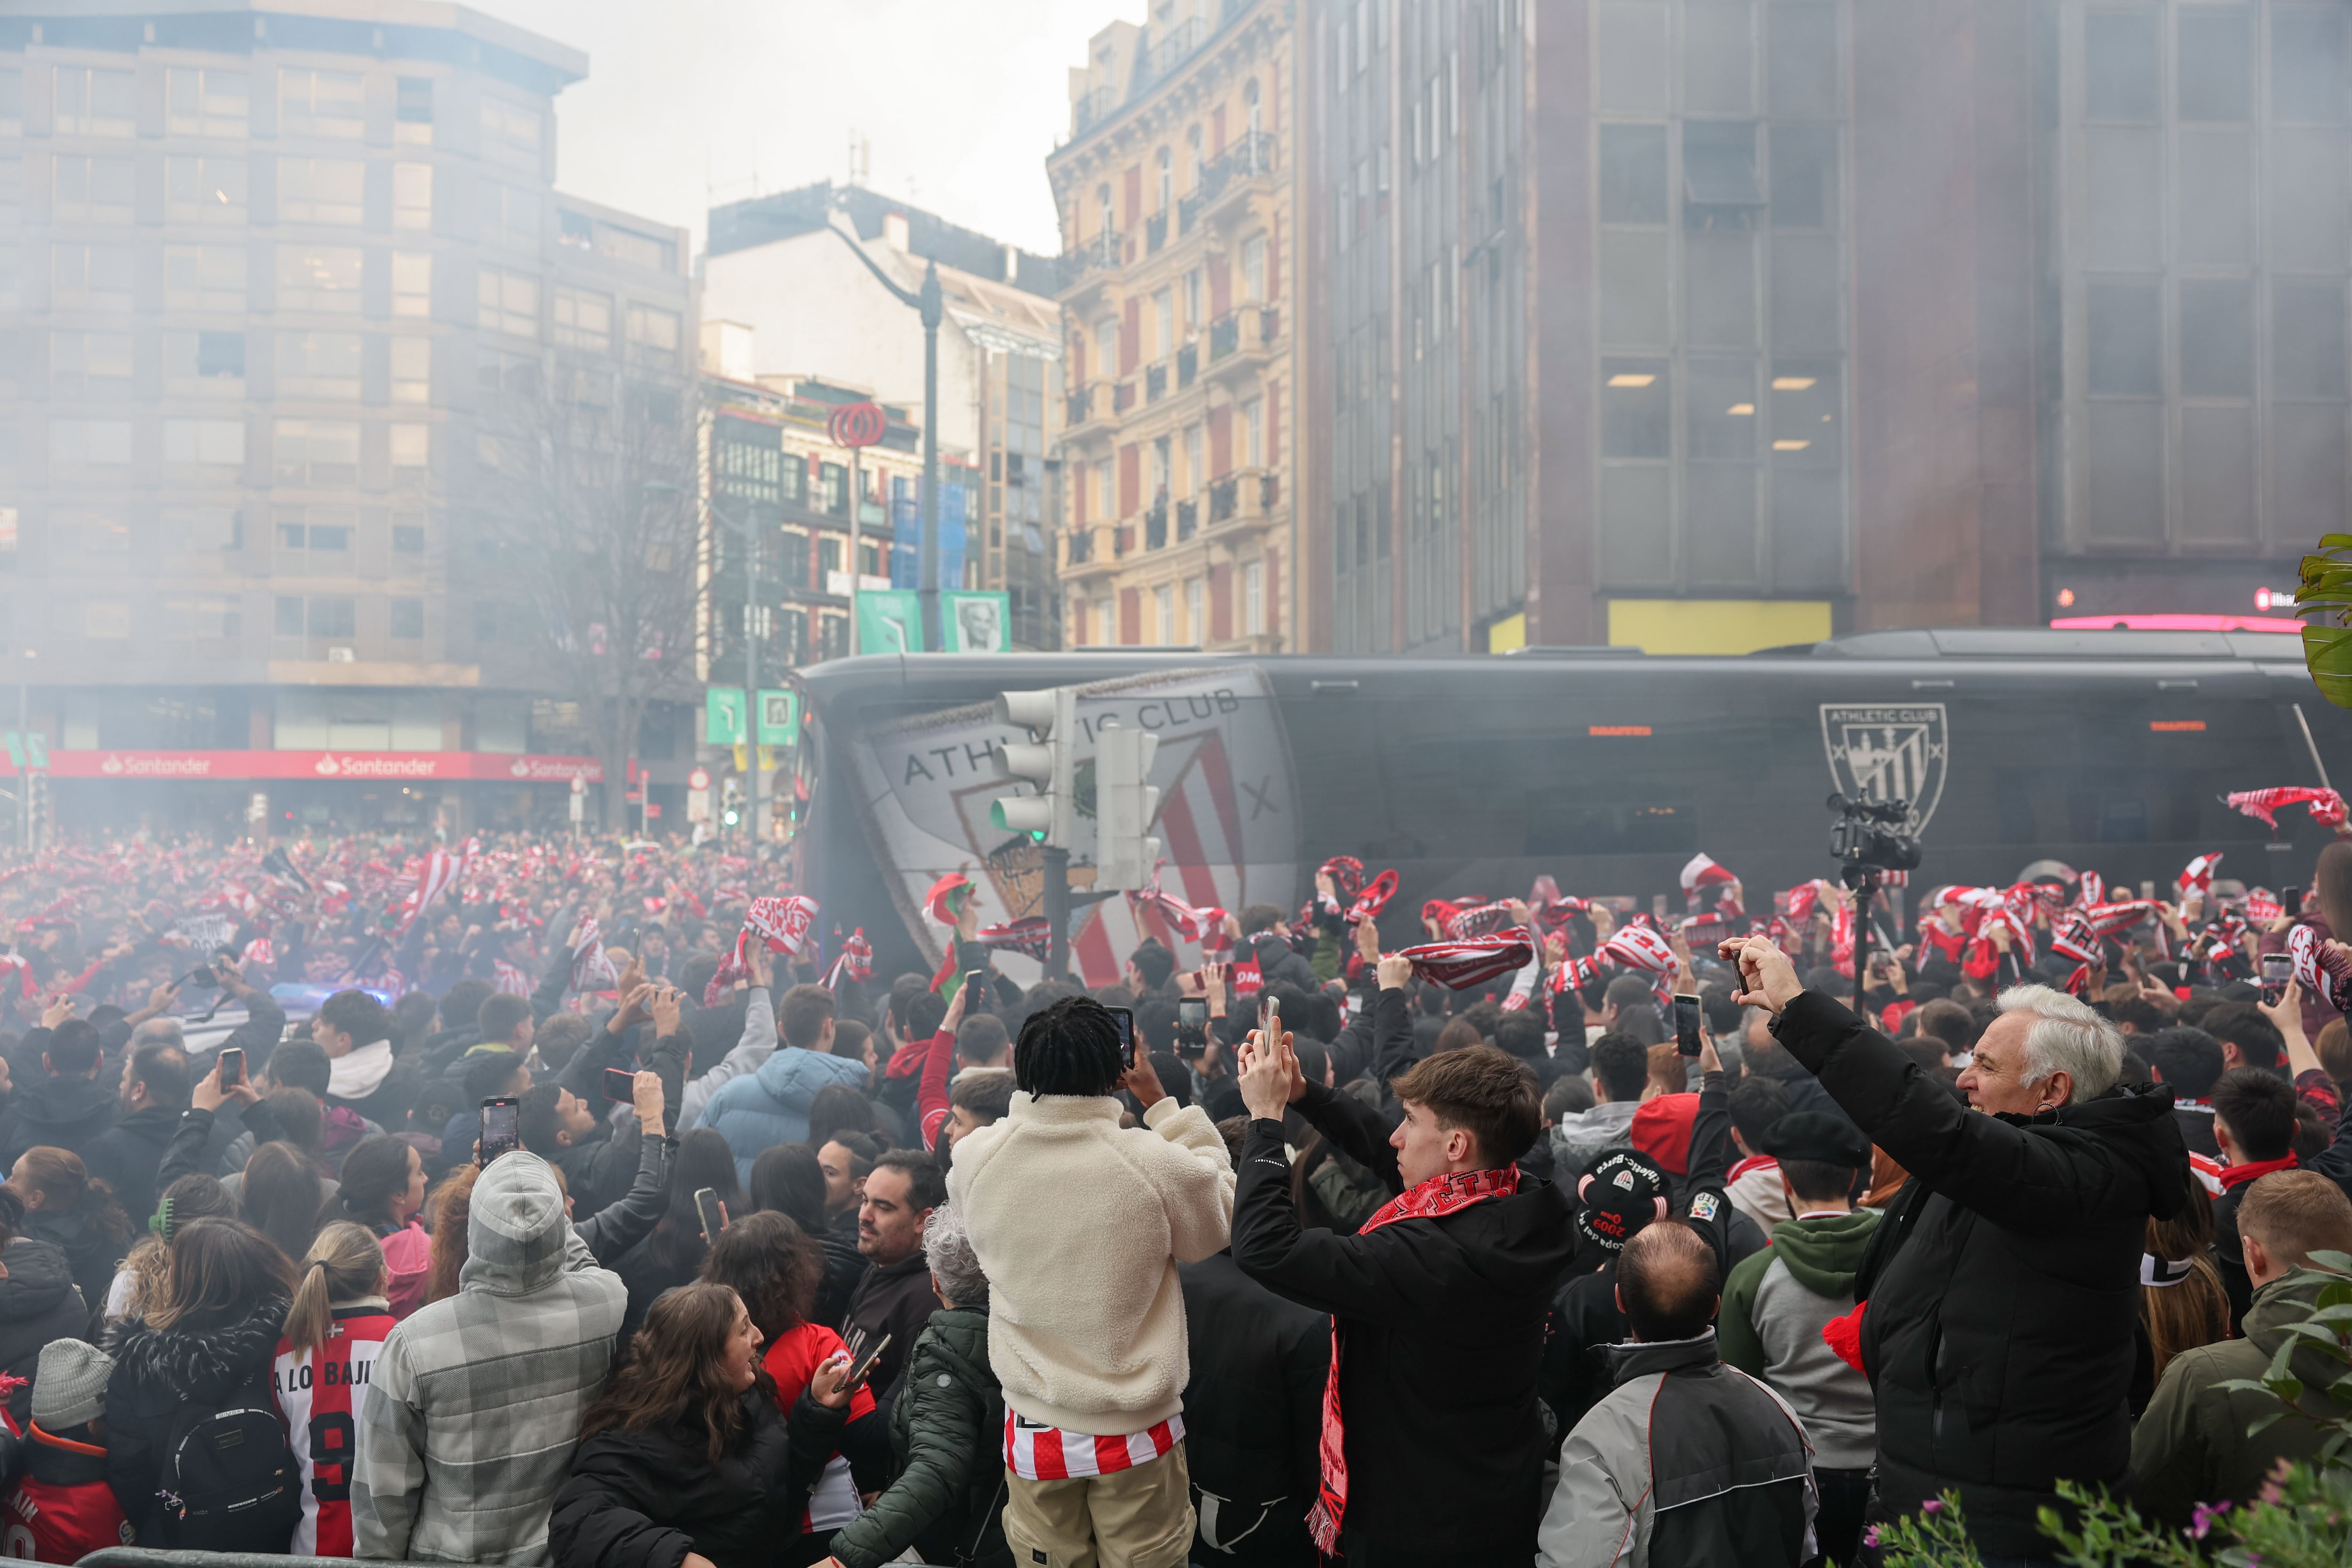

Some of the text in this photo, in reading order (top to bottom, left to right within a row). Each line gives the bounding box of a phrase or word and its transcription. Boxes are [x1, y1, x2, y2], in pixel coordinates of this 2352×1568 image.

[1137, 688, 1240, 730] CLUB
[1830, 709, 1938, 722] ATHLETIC CLUB
[125, 756, 210, 774] Santander
[342, 756, 436, 775] Santander
[530, 760, 601, 778] Santander
[1255, 1159, 1285, 1168] FUTURELIGHT
[1698, 1194, 1717, 1206] LFP
[1583, 1226, 1599, 1240] del
[1593, 1219, 1626, 1237] 2009
[289, 1365, 313, 1392] LO
[324, 1360, 375, 1385] BAJI
[218, 1409, 242, 1418] BIMBA
[308, 1411, 355, 1502] 9
